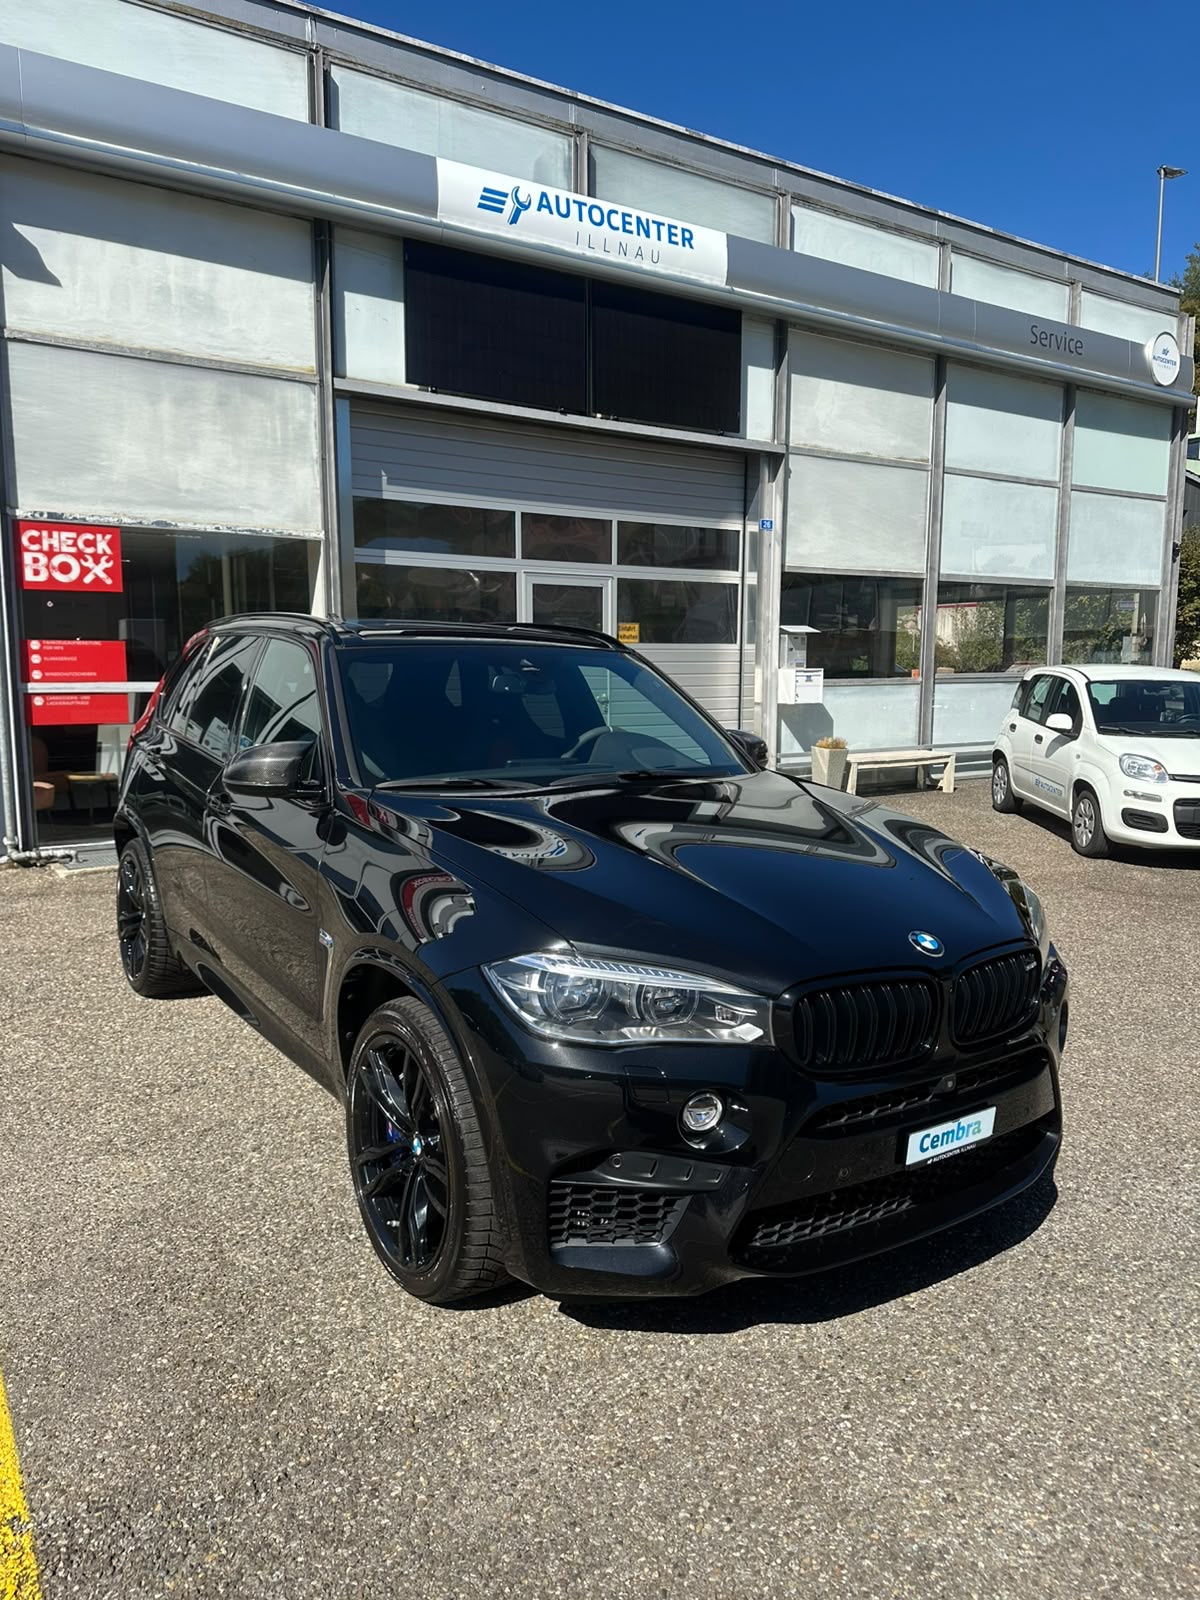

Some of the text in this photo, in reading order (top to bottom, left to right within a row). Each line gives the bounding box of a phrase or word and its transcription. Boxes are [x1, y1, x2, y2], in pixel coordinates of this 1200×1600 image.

[536, 191, 695, 250] AUTOCENTER
[575, 231, 662, 265] ILLNAU
[1029, 324, 1084, 357] Service
[1152, 355, 1177, 367] AUTOCENTER
[762, 520, 772, 529] 26
[21, 529, 113, 555] CHECK
[23, 551, 114, 586] BOX
[919, 1119, 982, 1153] Cembra
[933, 1143, 977, 1162] AUTOCENTER ILLNAU
